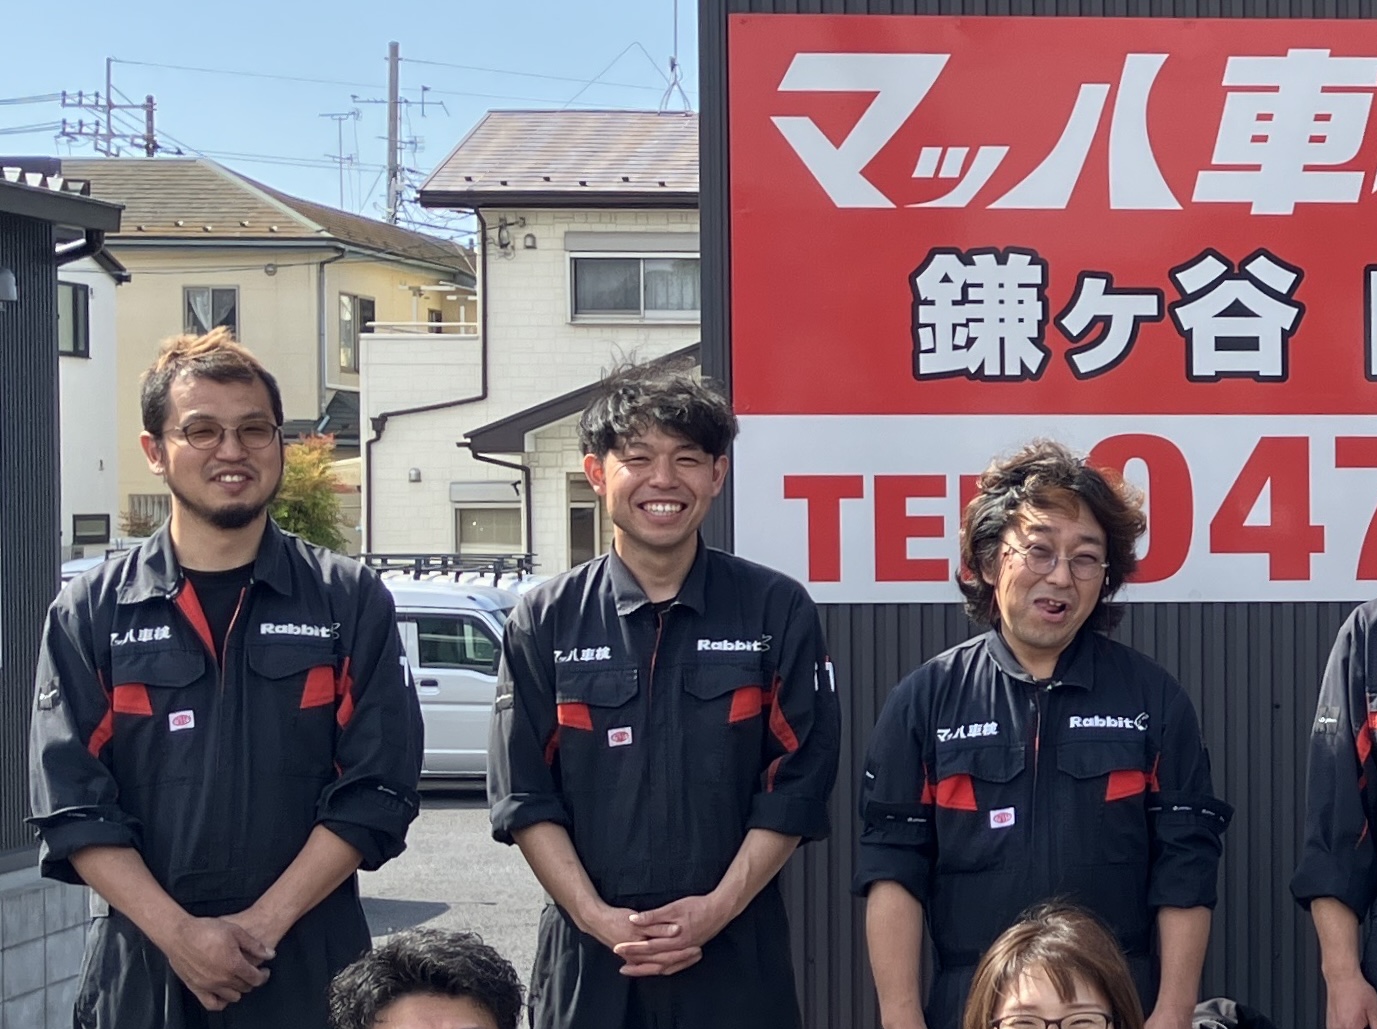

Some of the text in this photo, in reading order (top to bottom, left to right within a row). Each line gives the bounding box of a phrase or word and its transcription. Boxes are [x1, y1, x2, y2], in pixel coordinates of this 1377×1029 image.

[783, 474, 986, 584] TE
[260, 622, 331, 638] Rabbit
[697, 639, 762, 652] Rabbit
[1069, 715, 1134, 729] Rabbit
